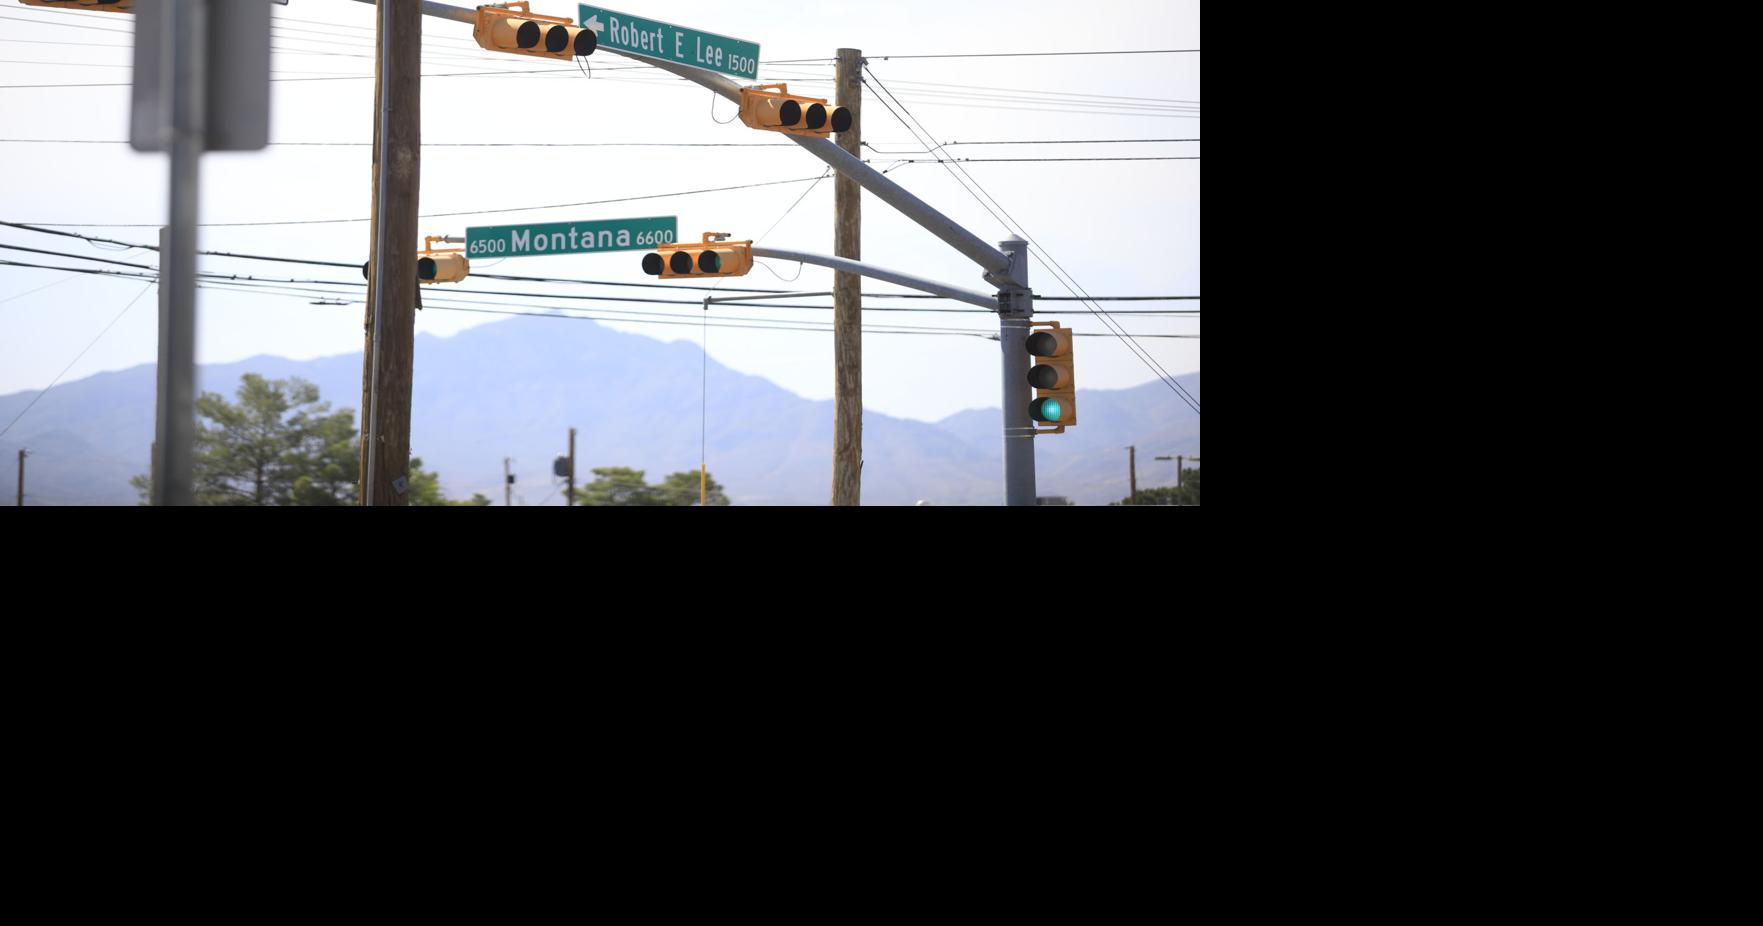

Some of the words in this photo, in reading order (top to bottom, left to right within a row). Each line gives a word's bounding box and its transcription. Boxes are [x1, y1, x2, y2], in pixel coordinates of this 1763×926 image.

[609, 16, 664, 54] Robert
[675, 31, 684, 58] E
[696, 36, 723, 67] Lee
[728, 53, 755, 74] 1500
[469, 238, 506, 254] 6500
[511, 227, 631, 252] Montana
[636, 230, 674, 245] 6600
